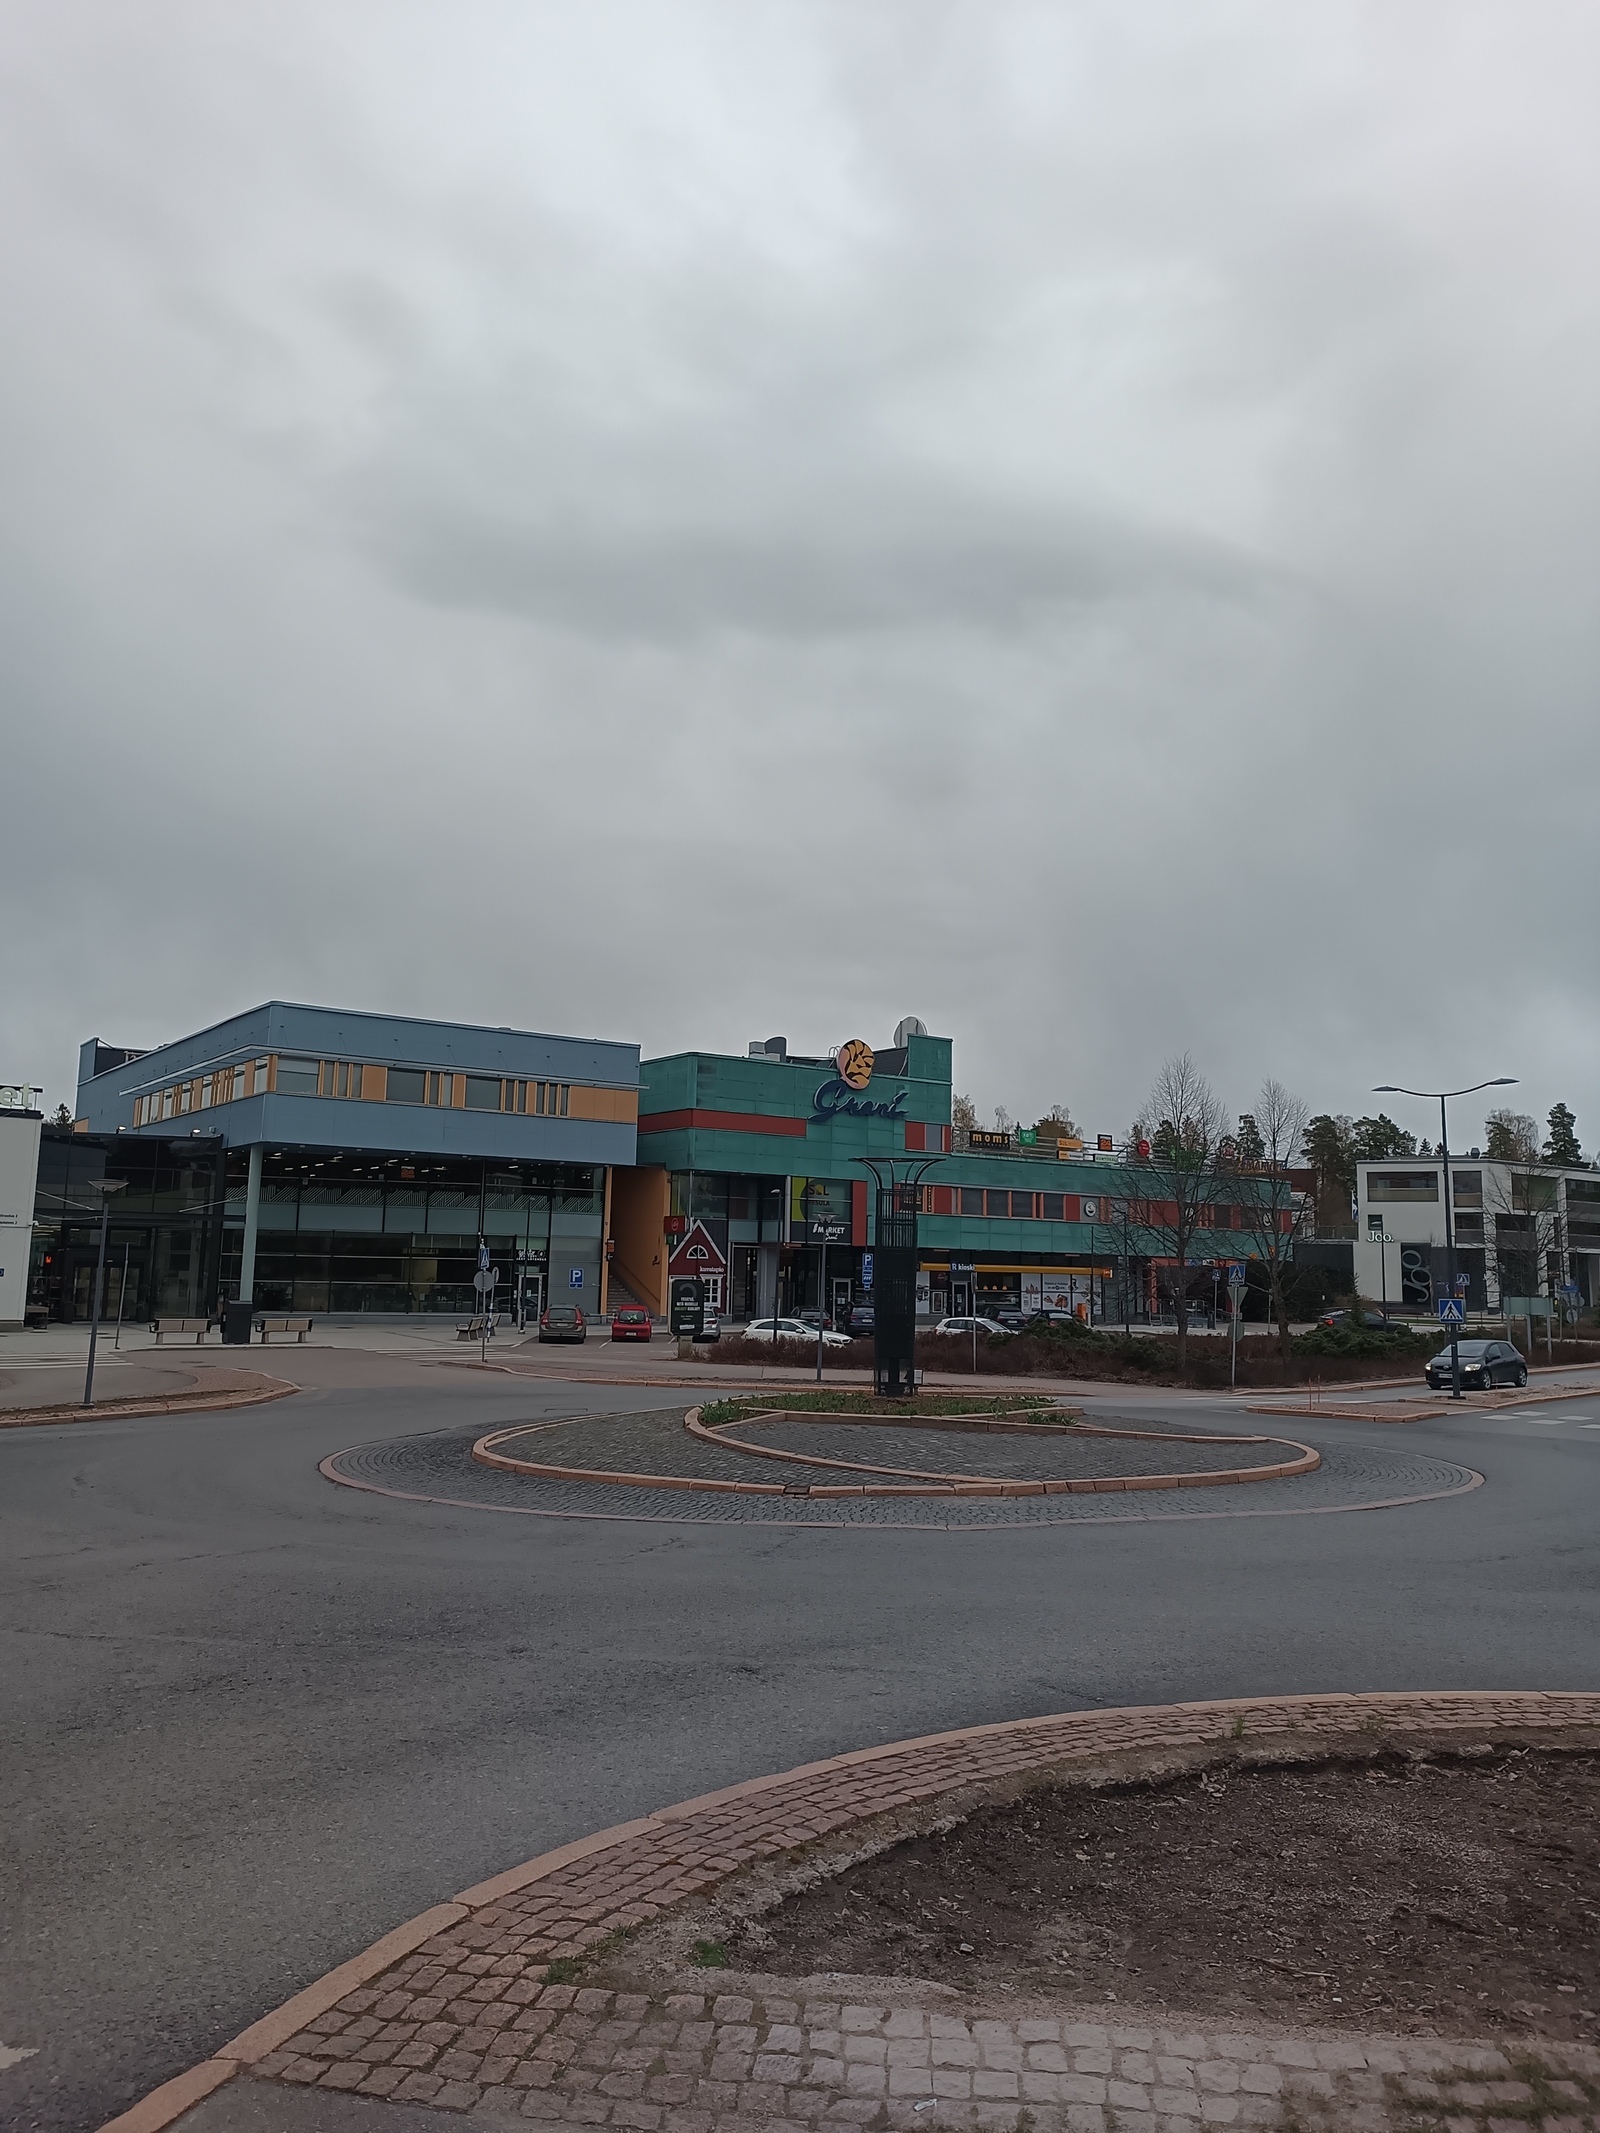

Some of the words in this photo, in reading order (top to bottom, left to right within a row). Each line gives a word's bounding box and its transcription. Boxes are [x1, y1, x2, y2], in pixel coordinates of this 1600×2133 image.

[972, 1133, 1009, 1144] moms
[808, 1184, 829, 1196] SOL
[1367, 1231, 1394, 1242] Joo.
[865, 1255, 872, 1265] P
[951, 1262, 957, 1271] R
[958, 1263, 975, 1271] kioski
[573, 1270, 581, 1281] P
